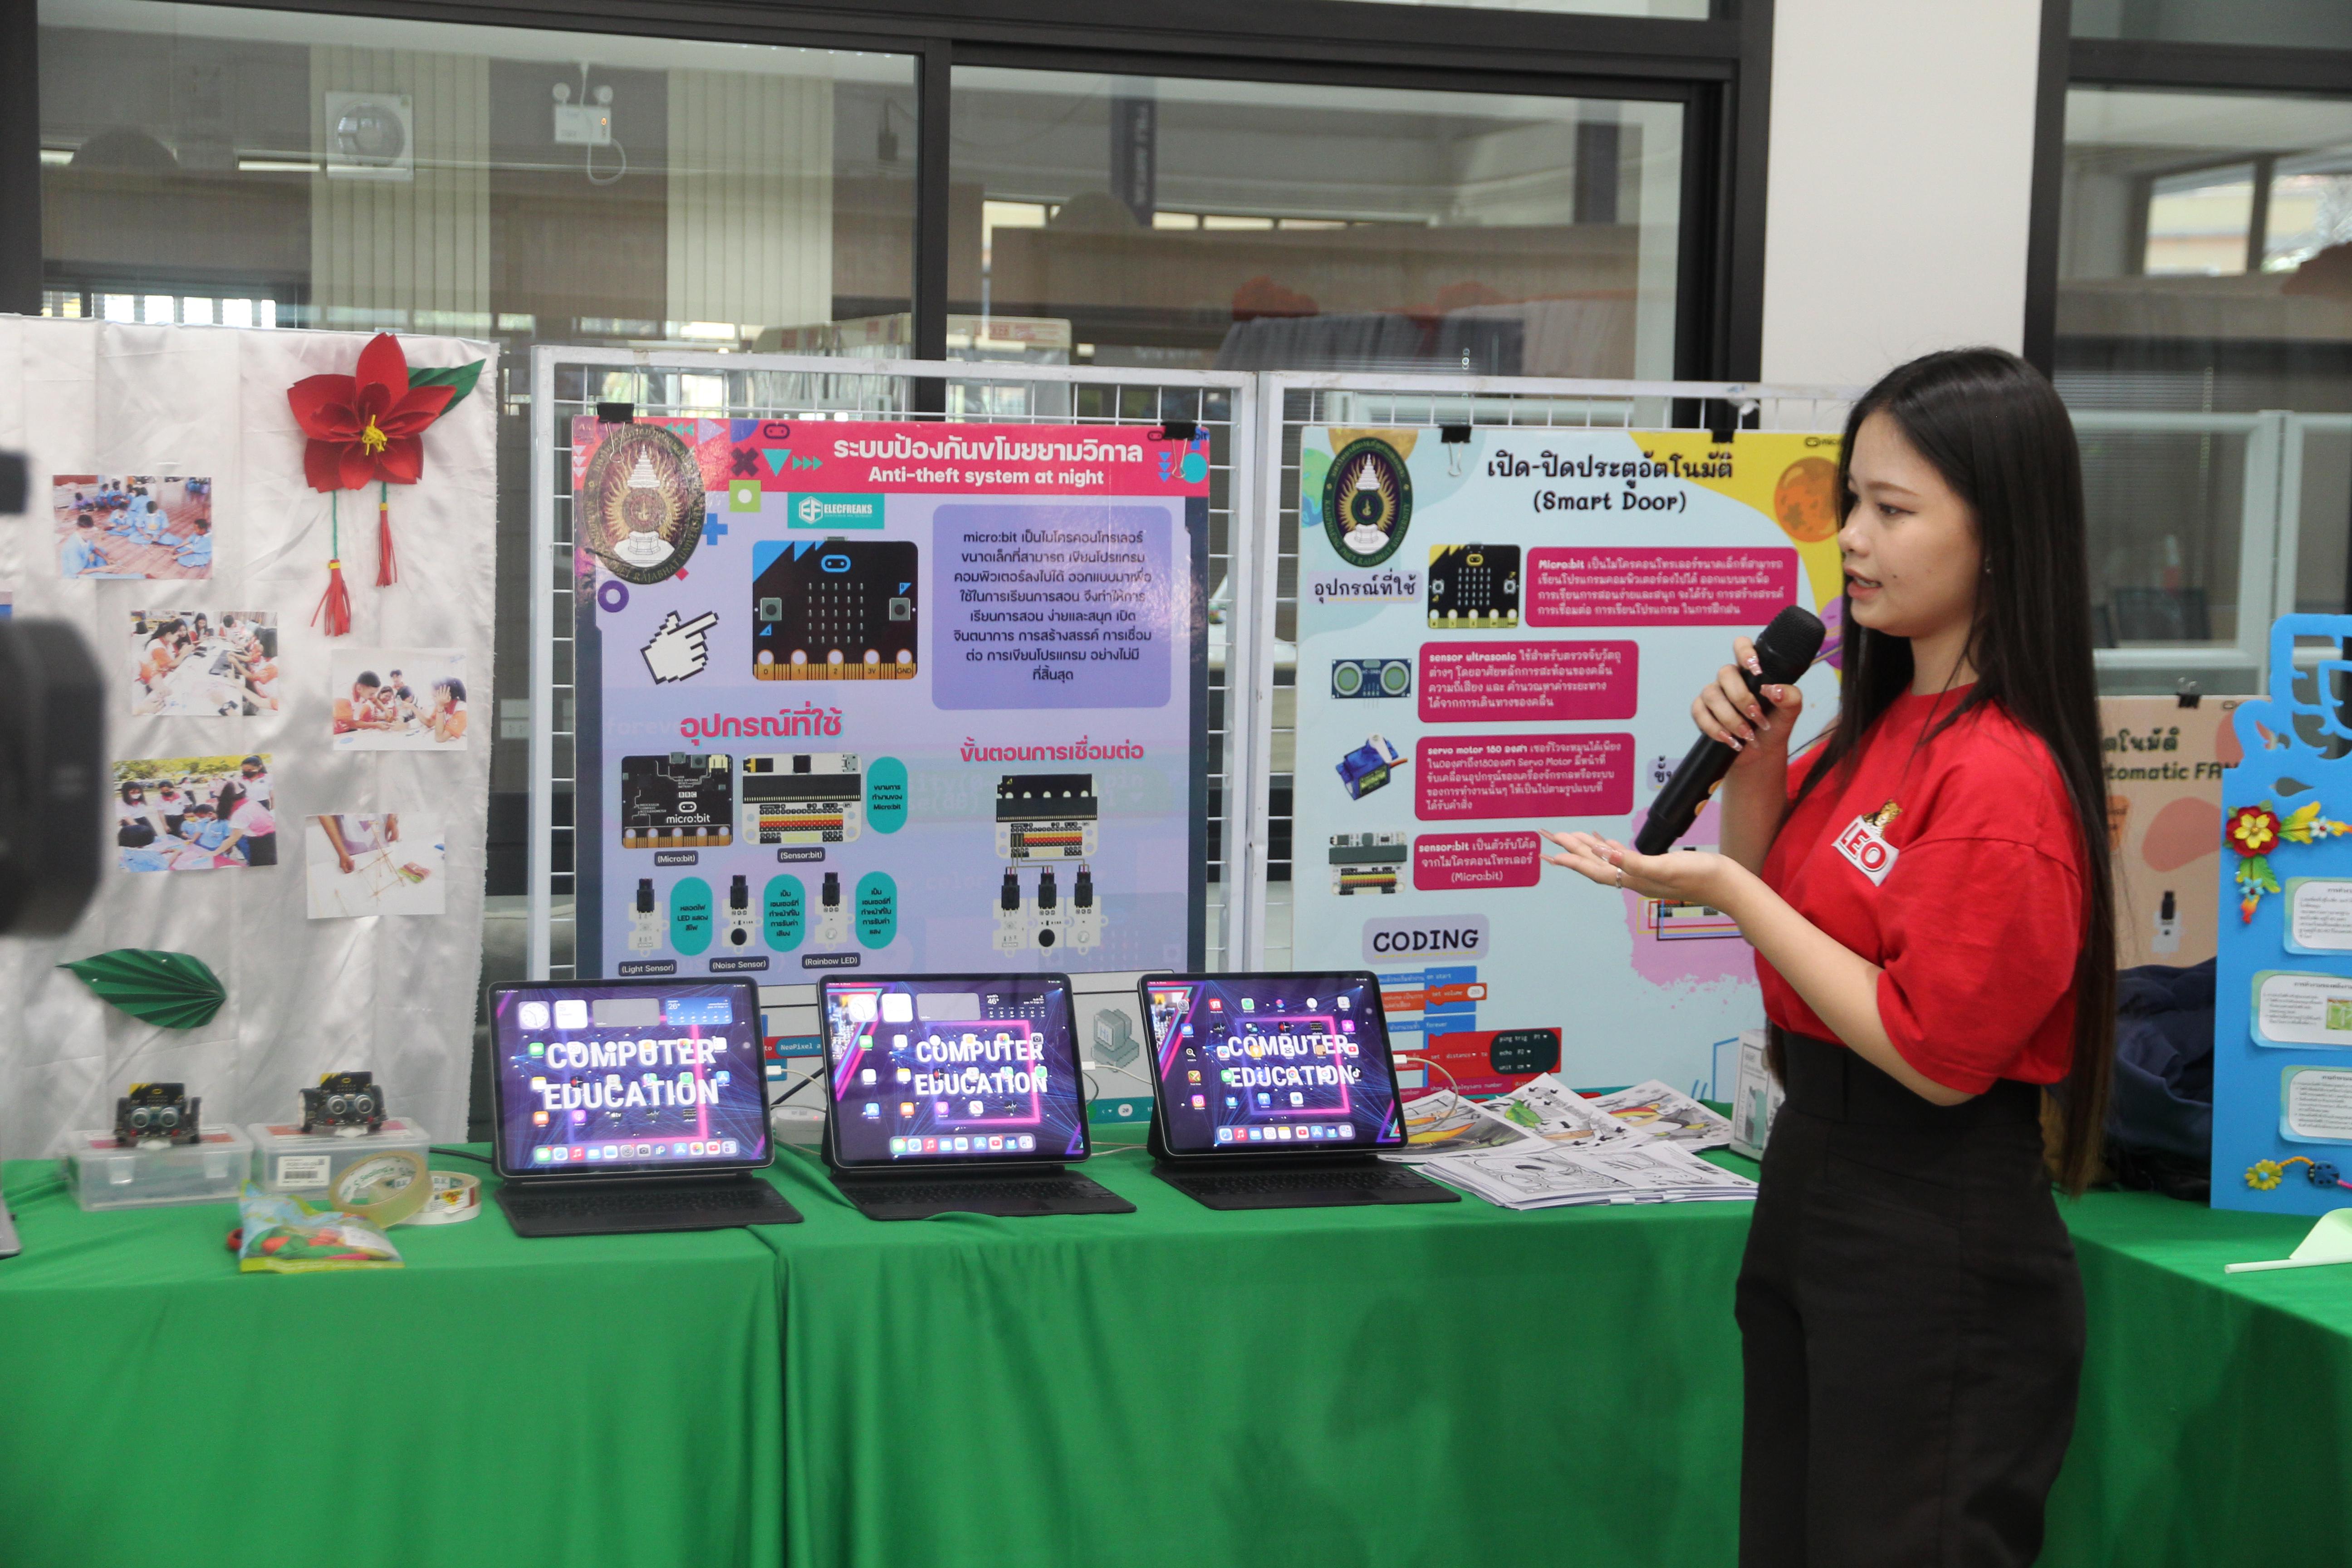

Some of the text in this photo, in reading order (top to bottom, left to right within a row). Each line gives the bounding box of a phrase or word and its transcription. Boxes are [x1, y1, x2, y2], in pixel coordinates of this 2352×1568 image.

[834, 433, 1143, 462] ระบบป้องกันขโมยยามวิกาล
[868, 466, 1104, 487] Anti-theft system at night
[1488, 449, 1732, 489] เปิด-ปิดประตูอัตโนมัติ
[823, 504, 872, 514] ELECFREAKS
[1534, 490, 1686, 513] (Smart Door)
[964, 532, 1017, 543] micro:bit
[961, 547, 1145, 563] ขนาดเล็กที่สามารถ เขียนโปรแกรม
[1539, 558, 1585, 569] Micro:bit
[1315, 568, 1416, 603] อุปกรณ์ที่ใช้
[960, 589, 1080, 602] ใช้ในการเรียนการสอน
[970, 609, 1136, 624] เรียนการสอน ง่ายและสนุก เปิด
[954, 625, 1152, 642] จินตนาการ การสร้างสรรค์ การเชื่อม
[966, 647, 1139, 661] ต่อ การเขียนโปรแกรม อย่างไม่มี
[1430, 654, 1463, 662] sensor
[1465, 651, 1517, 662] ultrasonic
[1033, 665, 1073, 683] ที่สิ้นสุด
[680, 701, 843, 746] อุปกรณ์ที่ใช้
[2104, 726, 2180, 752] ตโนมัติ
[960, 735, 1144, 762] ขั้นตอนการเชื่อมต่อ
[1456, 746, 1483, 754] motor
[1518, 758, 1544, 767] Servo
[1546, 757, 1573, 766] Motor
[2107, 761, 2239, 780] tomatic FA
[666, 813, 710, 823] micro:bit
[1418, 841, 1470, 853] sensor:bit
[1840, 822, 1887, 870] LEO
[657, 854, 696, 864] (Micro:bit)
[780, 851, 823, 859] (Sensor:bit)
[1451, 871, 1503, 883] (Micro:bit)
[1373, 929, 1479, 952] CODING
[622, 963, 674, 974] (Light Sensor)
[713, 959, 766, 970] (Noise Sensor)
[805, 956, 858, 966] (Rainbow LED)
[547, 1038, 716, 1069] COMPUTER
[780, 1042, 813, 1051] NeoPixel
[916, 1039, 1045, 1063] COMPUTER
[1228, 1034, 1349, 1057] COMPUTER
[914, 1072, 1049, 1095] EDUCATION
[1228, 1064, 1355, 1088] EDUCATION
[544, 1078, 720, 1110] EDUCATION
